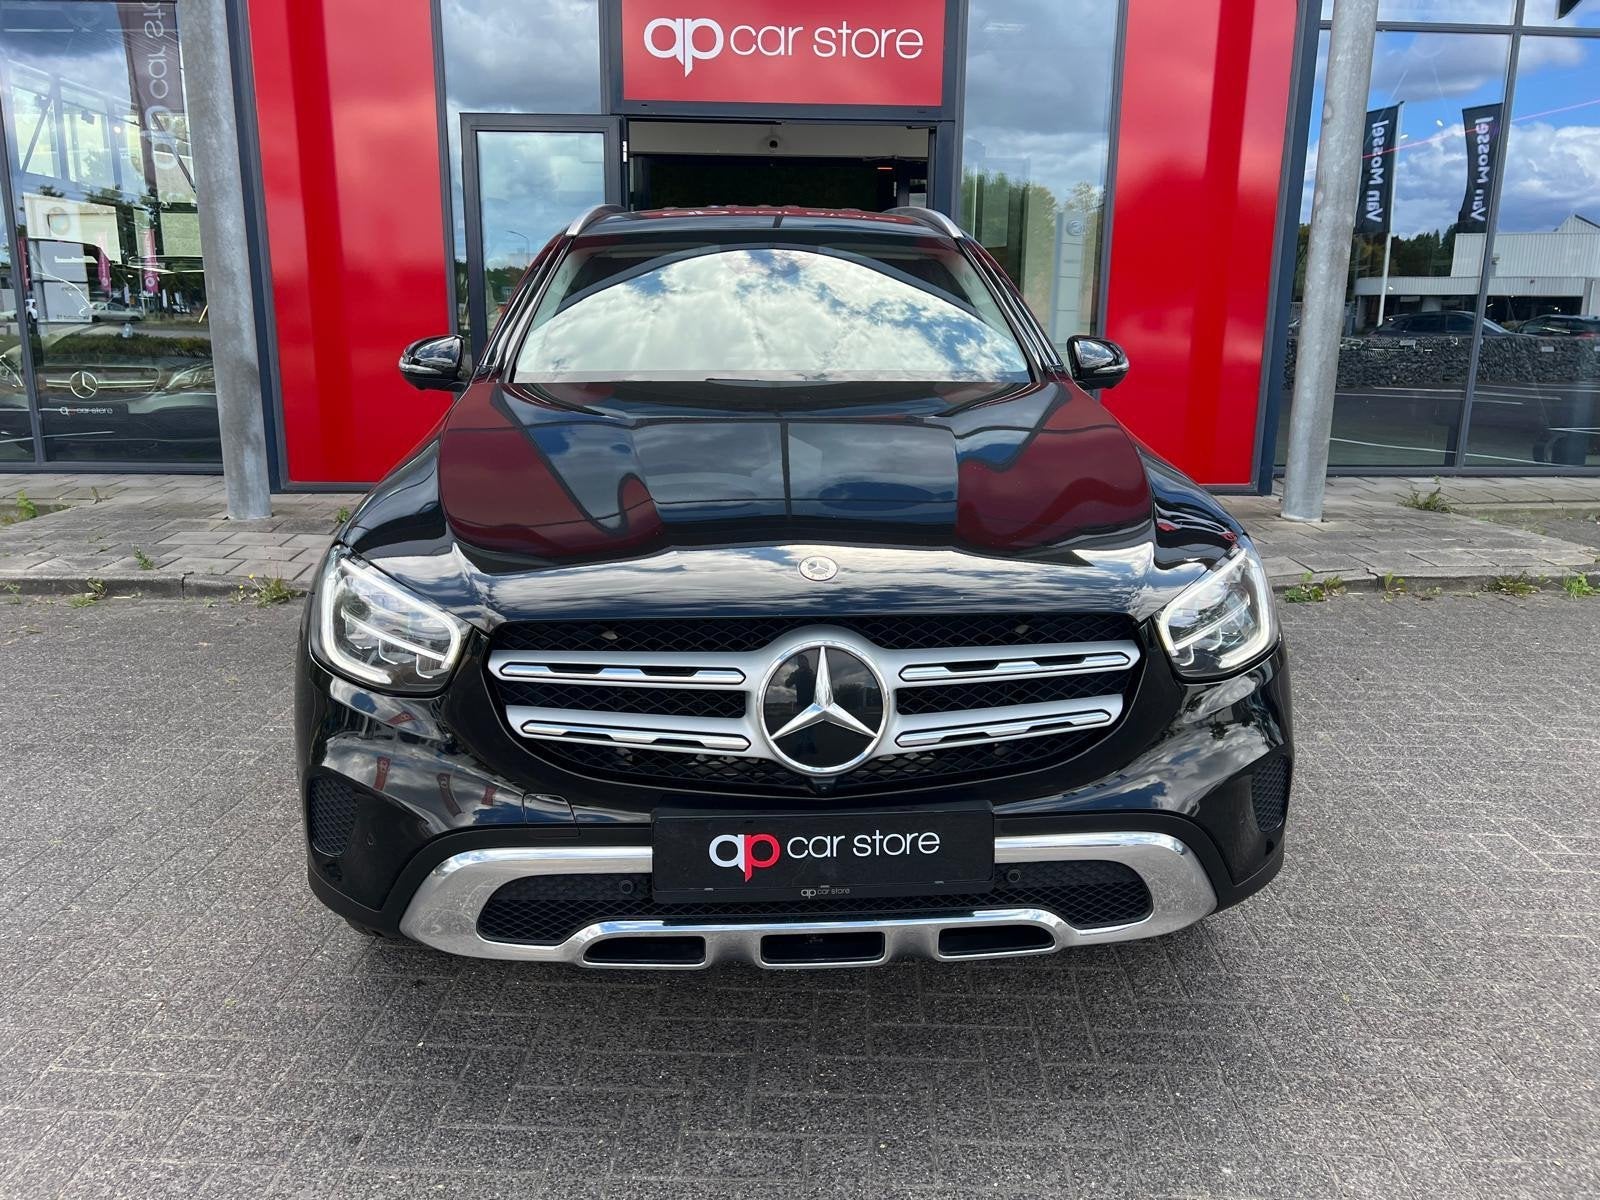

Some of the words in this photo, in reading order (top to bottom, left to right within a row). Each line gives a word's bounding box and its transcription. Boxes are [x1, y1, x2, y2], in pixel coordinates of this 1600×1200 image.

[644, 18, 724, 77] ap
[730, 26, 804, 57] car
[813, 21, 924, 58] store
[709, 834, 780, 883] ap
[787, 835, 845, 858] car
[853, 830, 940, 857] store
[800, 889, 816, 899] ap
